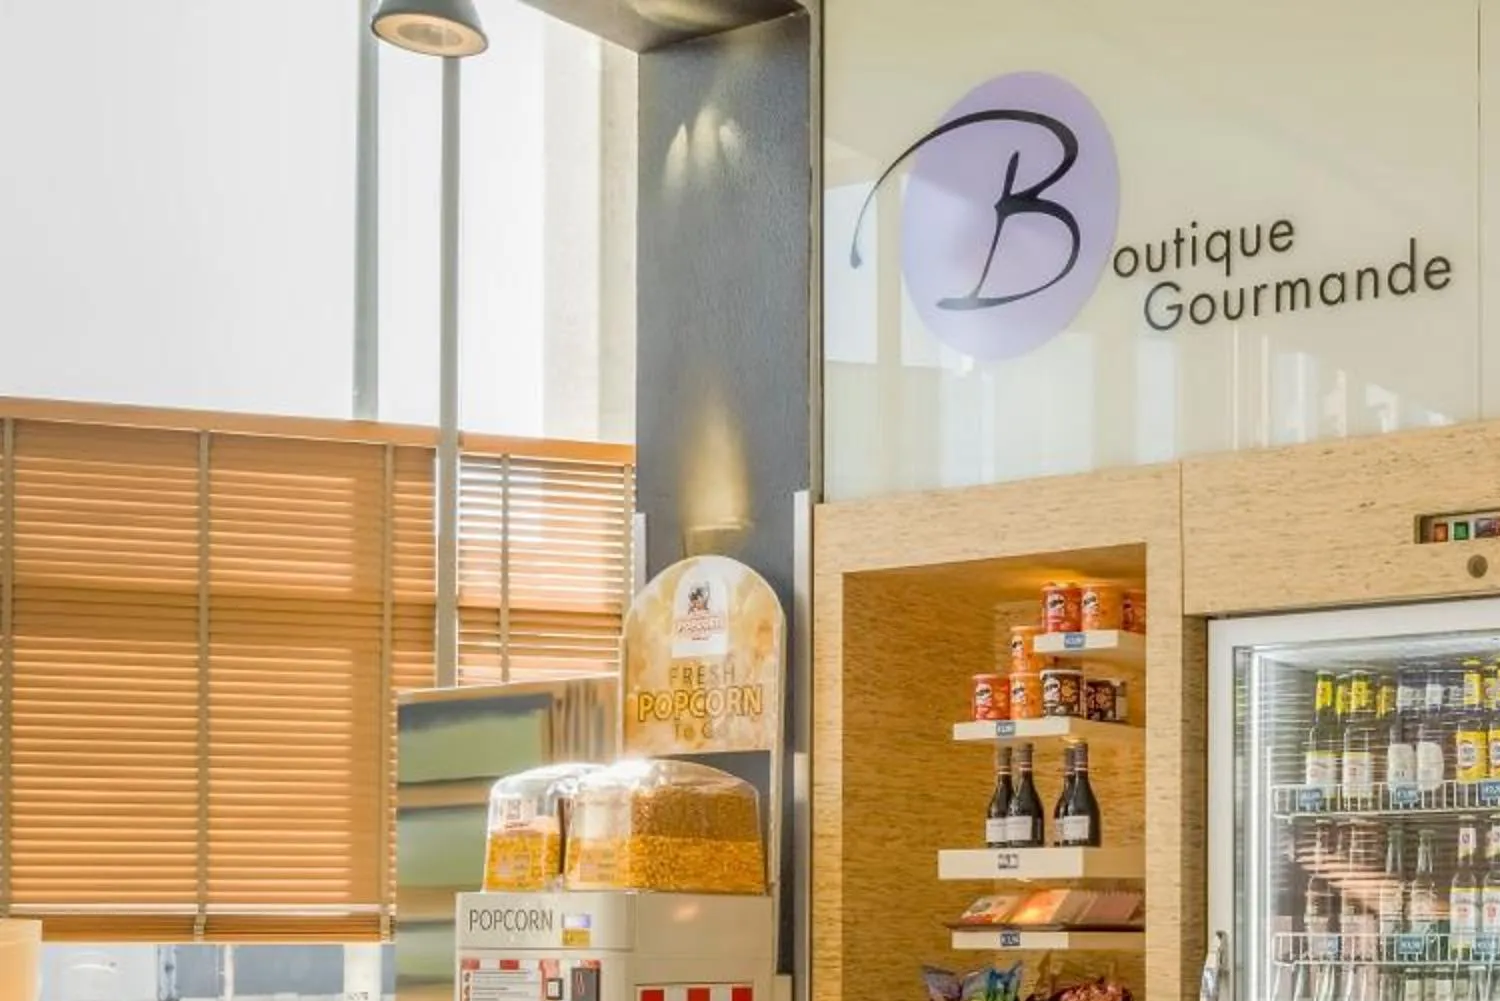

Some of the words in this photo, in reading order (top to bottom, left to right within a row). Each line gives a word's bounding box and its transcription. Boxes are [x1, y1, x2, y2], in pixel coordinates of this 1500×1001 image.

[1143, 237, 1454, 332] Gourmande
[670, 664, 735, 686] FRESH
[638, 684, 764, 723] POPCORN
[469, 909, 554, 932] POPCORN
